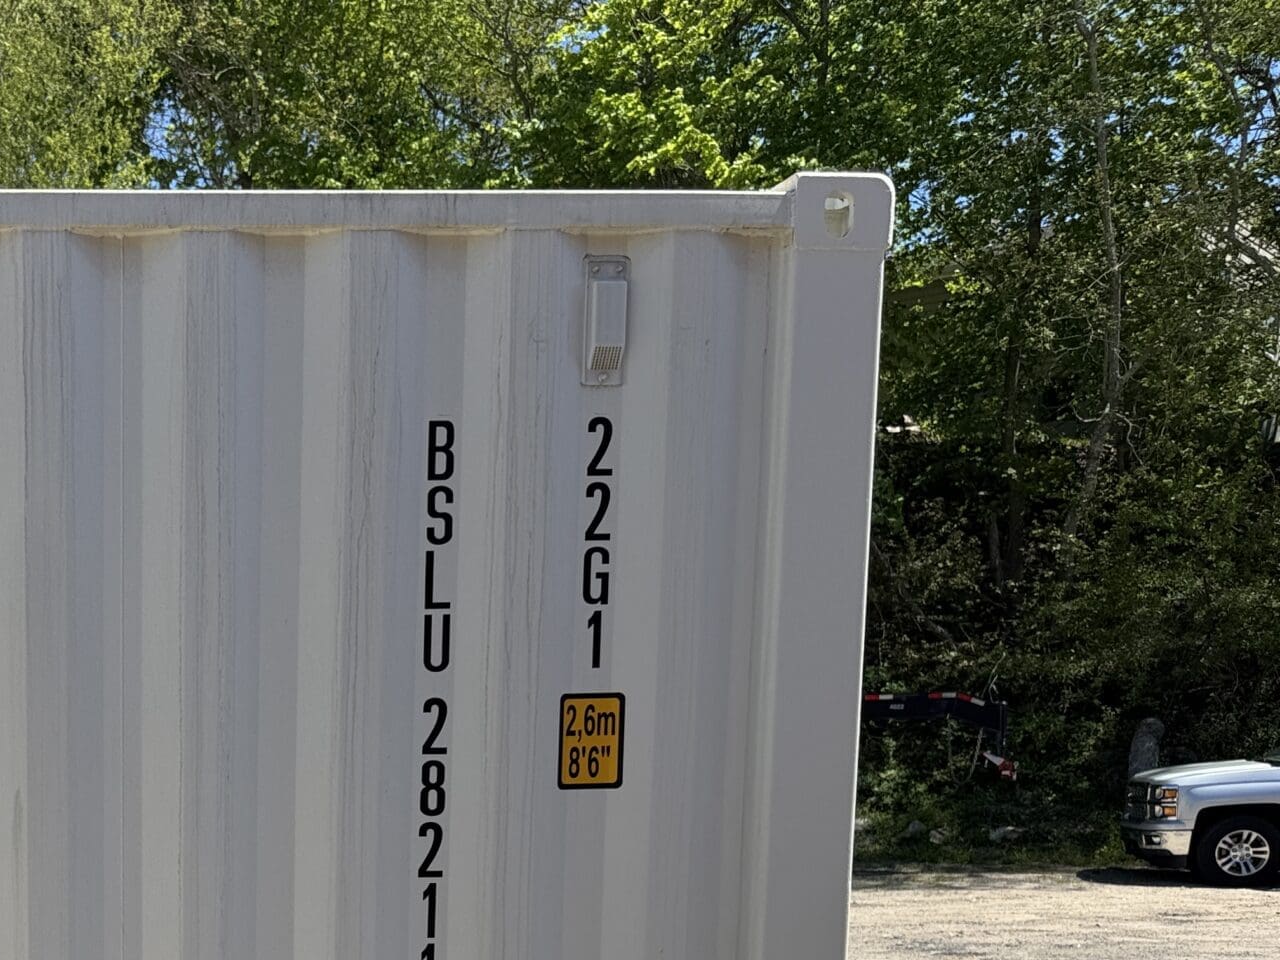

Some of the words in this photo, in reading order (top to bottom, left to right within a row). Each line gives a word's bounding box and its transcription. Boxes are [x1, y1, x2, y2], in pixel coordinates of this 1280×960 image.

[423, 420, 455, 672] BSLU
[582, 416, 613, 668] 22G1
[565, 704, 616, 742] 2,6m
[568, 745, 611, 779] 8'6"
